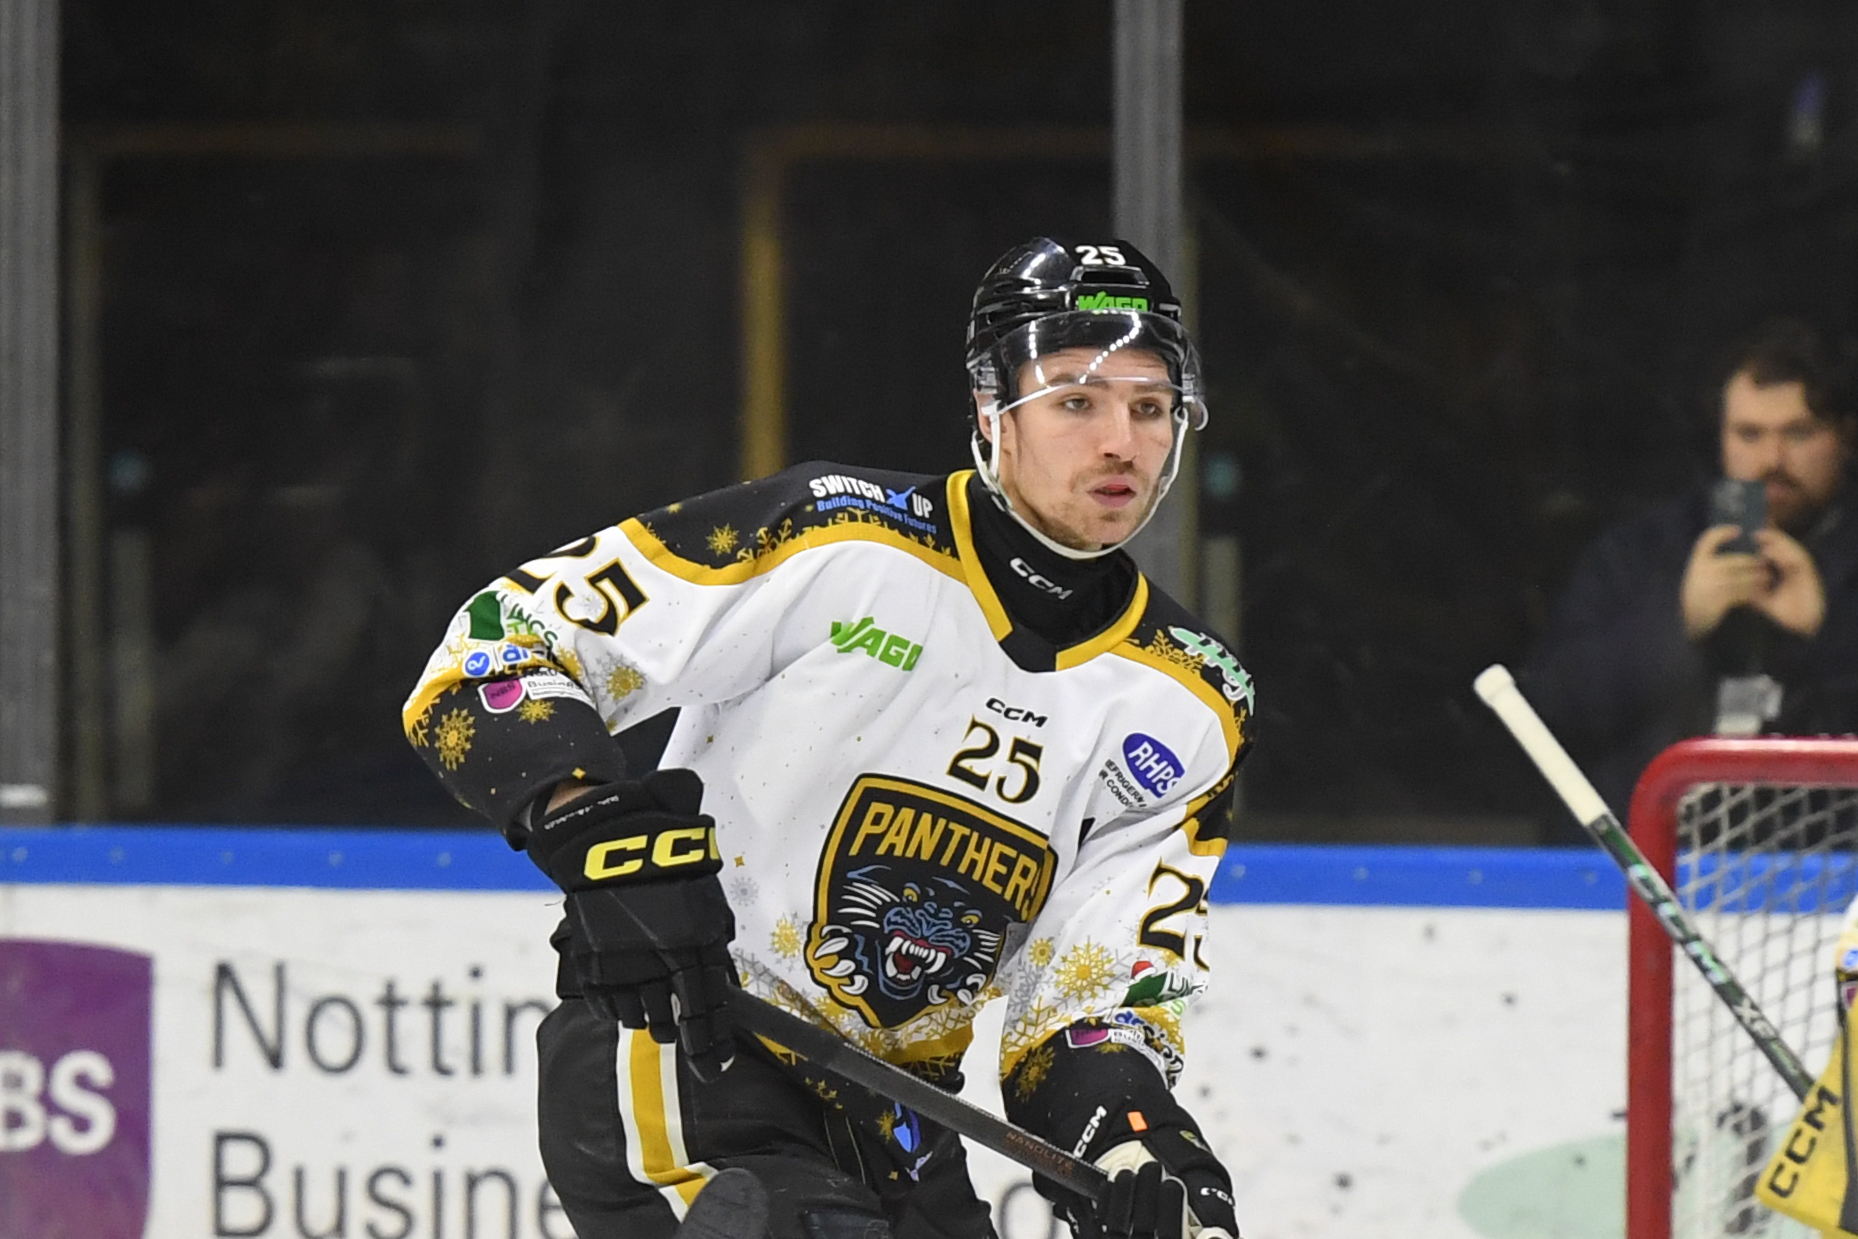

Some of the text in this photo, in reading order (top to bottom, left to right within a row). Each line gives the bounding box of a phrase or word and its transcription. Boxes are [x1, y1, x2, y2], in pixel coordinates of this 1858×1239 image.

[1076, 245, 1126, 266] 25
[1078, 291, 1148, 314] WAGO
[809, 475, 934, 518] SWITCH UP
[816, 495, 937, 535] Building Positive Futures
[1009, 557, 1074, 600] CCM
[985, 696, 1048, 729] CCM
[946, 713, 1044, 804] 25
[1128, 741, 1182, 794] RHPS
[584, 826, 721, 881] CC
[210, 959, 549, 1077] Nottin
[0, 1049, 117, 1156] BS
[1073, 1105, 1108, 1159] CCM
[1768, 1085, 1841, 1199] CCM
